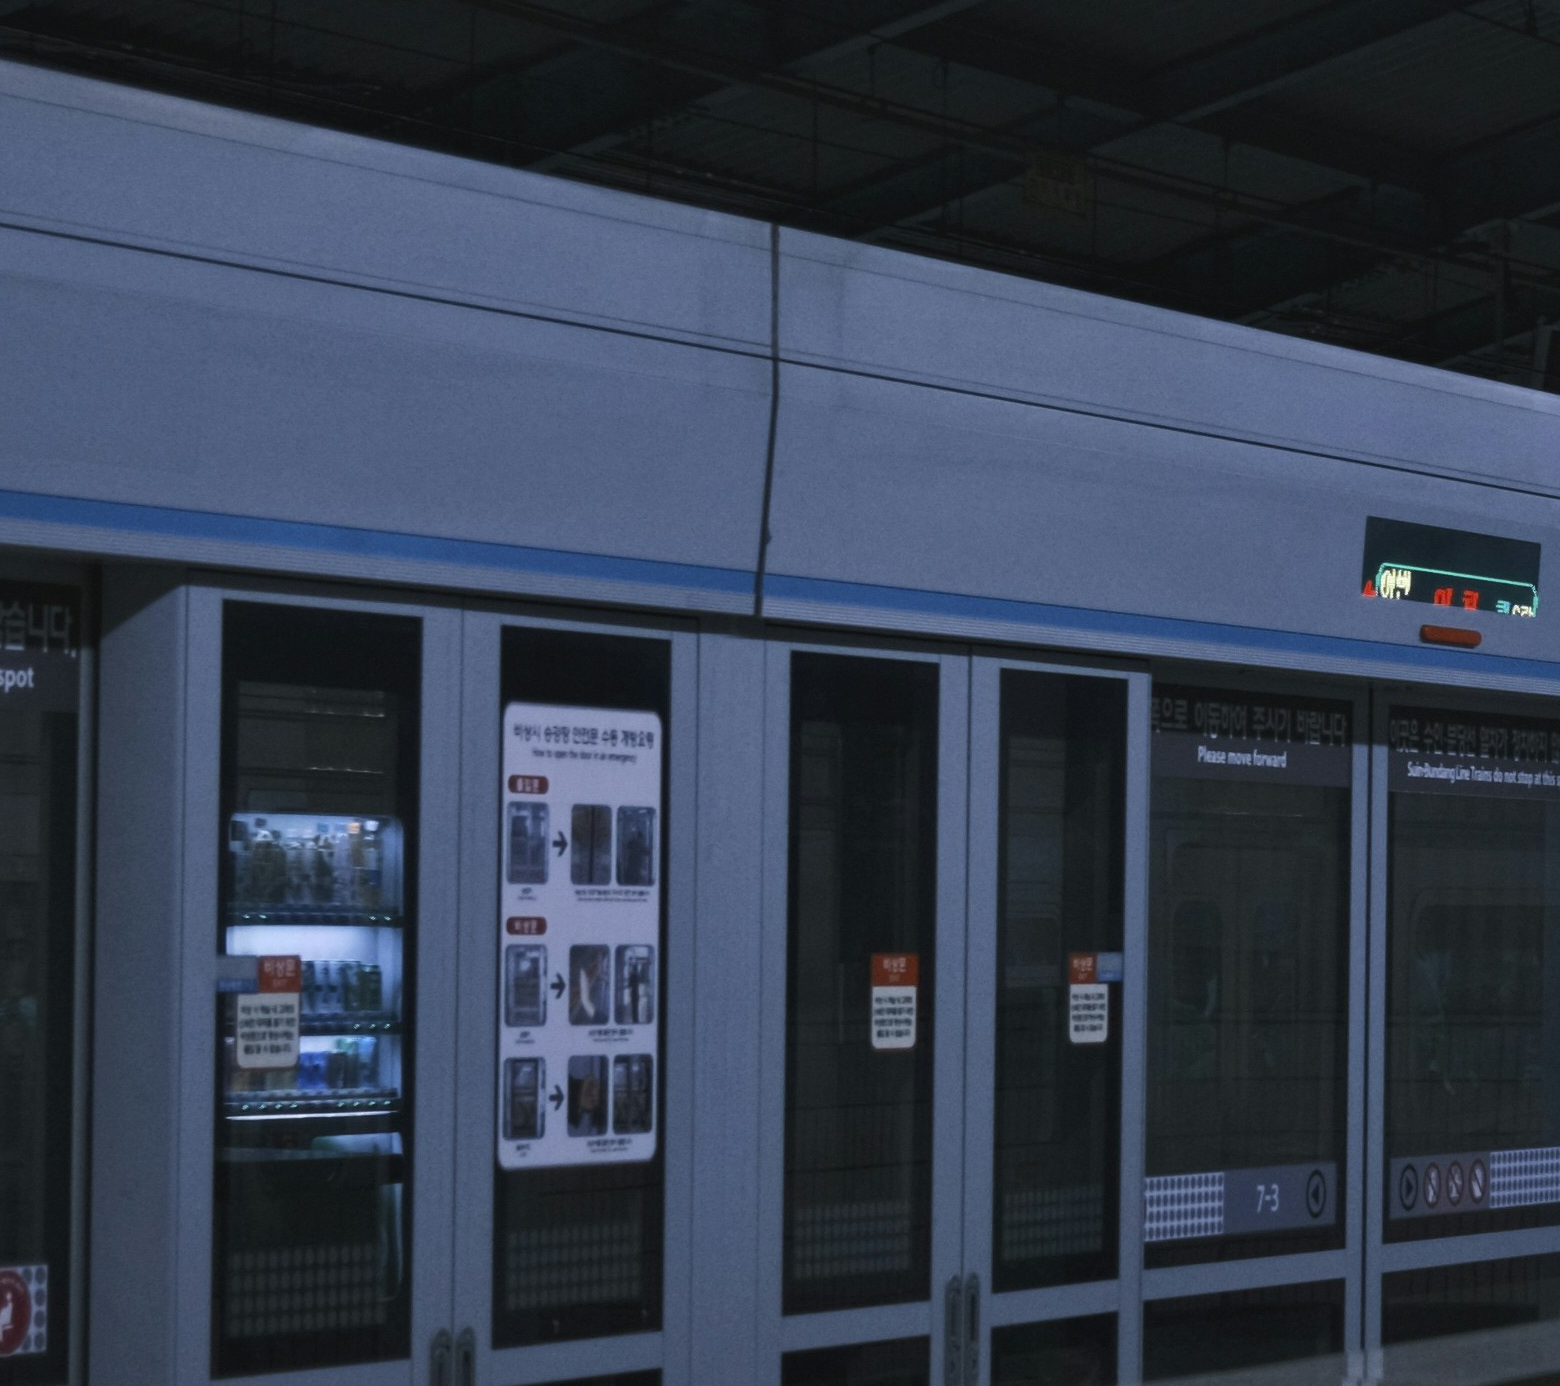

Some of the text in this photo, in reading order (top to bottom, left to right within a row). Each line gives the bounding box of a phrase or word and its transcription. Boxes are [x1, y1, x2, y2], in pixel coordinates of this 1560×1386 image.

[1252, 705, 1290, 744] 주시기
[1296, 709, 1347, 747] 바랍니다
[1197, 745, 1287, 768] Please move forward
[263, 958, 296, 978] 비상문
[1256, 1183, 1280, 1213] 7-3
